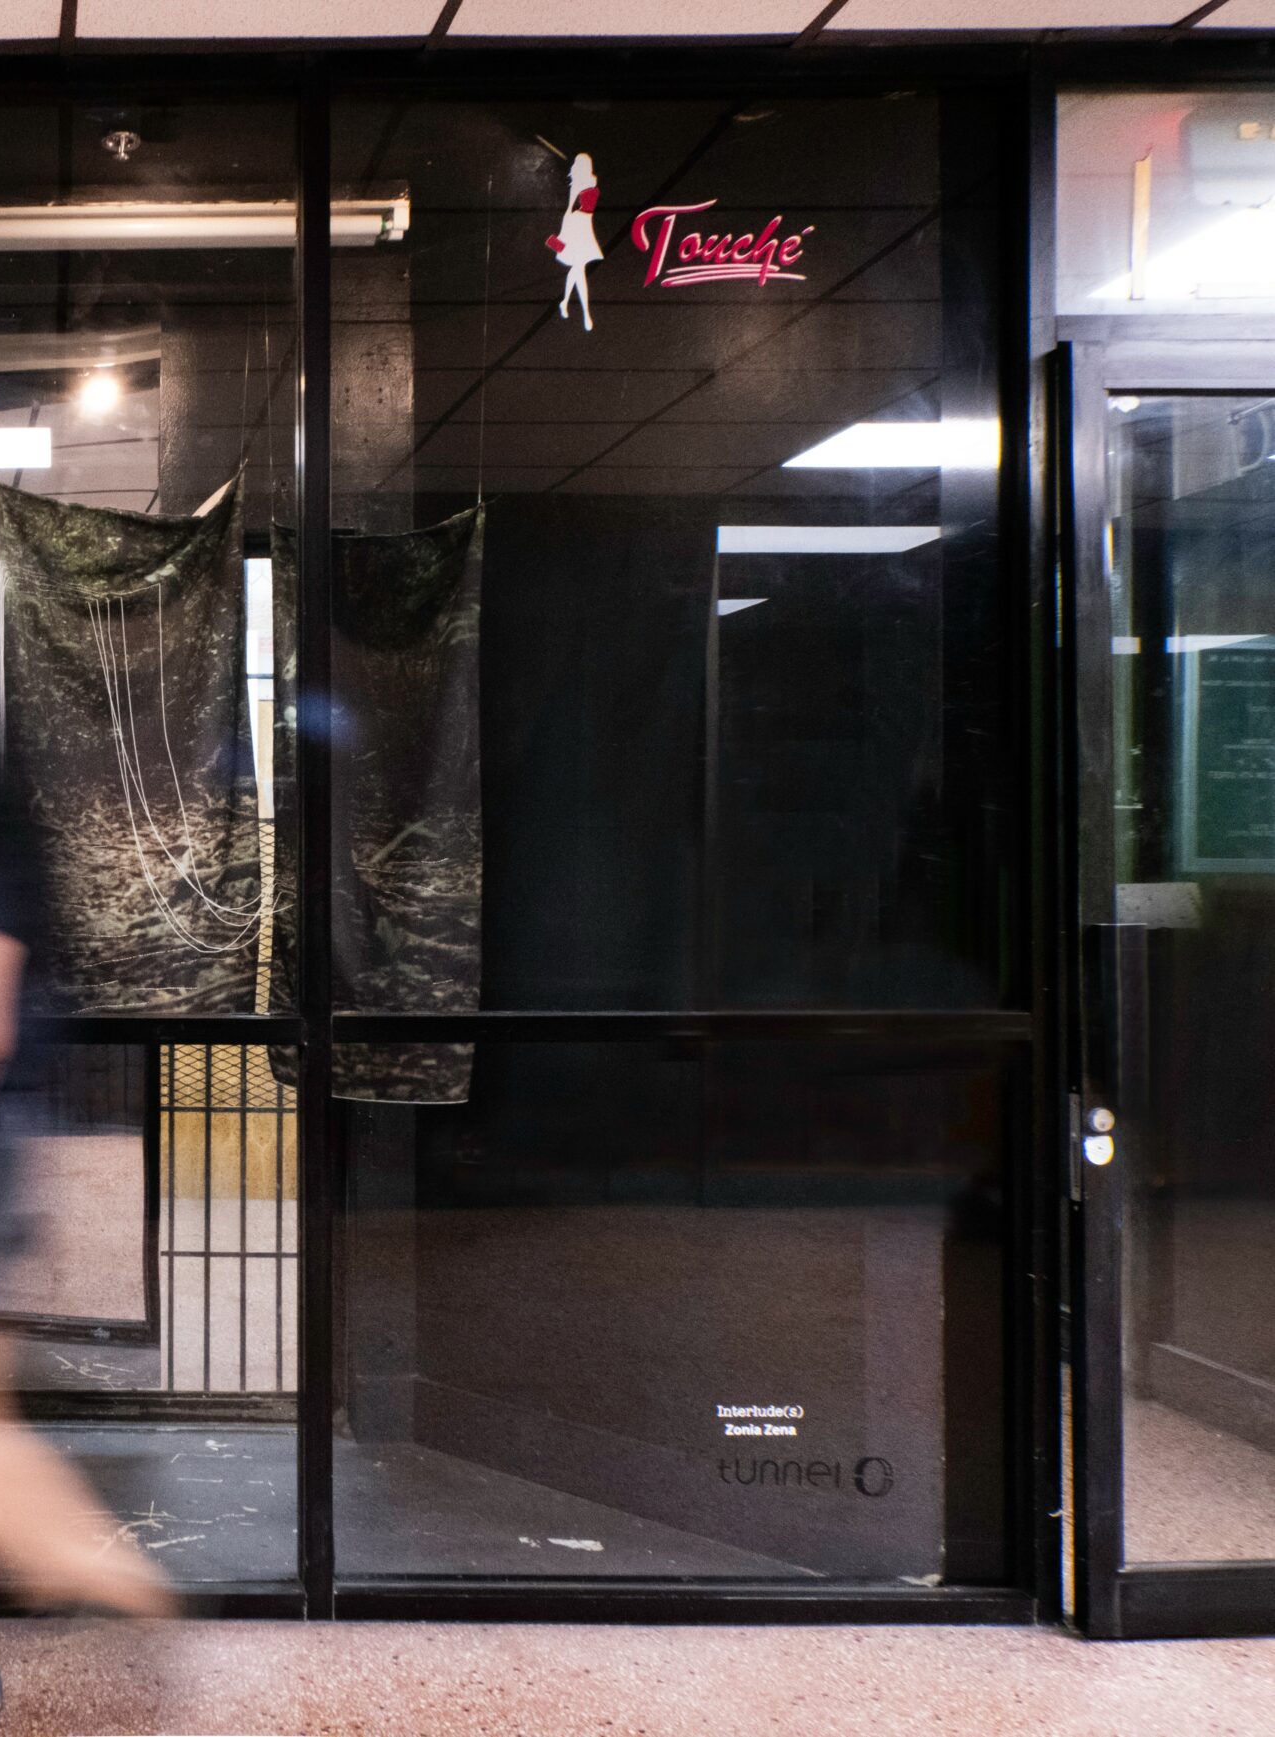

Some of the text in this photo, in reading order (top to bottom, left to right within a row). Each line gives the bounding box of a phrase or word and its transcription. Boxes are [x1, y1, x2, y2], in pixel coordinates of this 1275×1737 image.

[632, 199, 815, 287] Touché
[716, 1404, 805, 1419] Interlude(s)
[724, 1423, 798, 1436] Zonia Zena
[718, 1458, 841, 1487] tunnel
